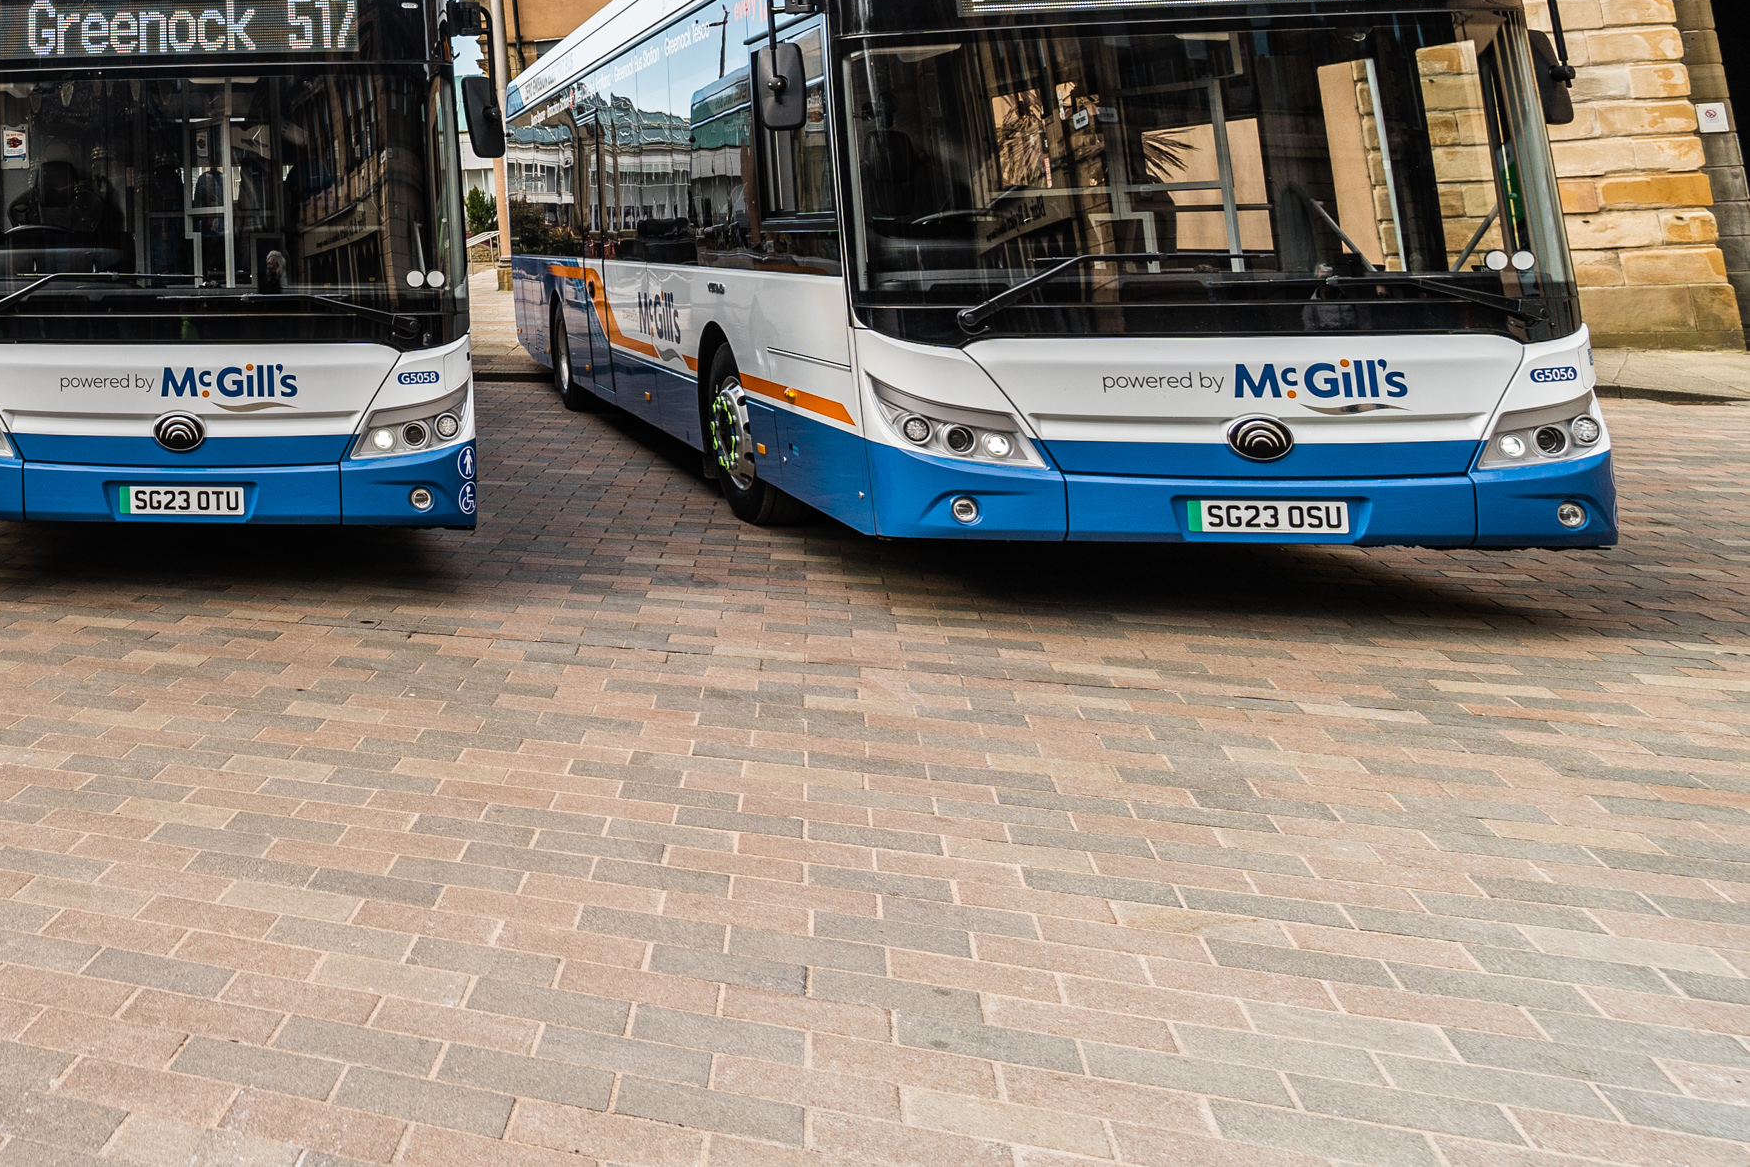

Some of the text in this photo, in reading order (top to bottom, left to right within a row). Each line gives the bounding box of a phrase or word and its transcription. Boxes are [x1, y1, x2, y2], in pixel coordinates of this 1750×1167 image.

[664, 28, 692, 57] Greenock
[691, 21, 709, 44] Tesco
[637, 290, 682, 345] McGill's
[59, 363, 298, 398] powered by McGill's
[400, 372, 437, 384] G5058
[1102, 358, 1408, 400] powered by McGill's
[1533, 367, 1575, 382] G5056
[134, 489, 239, 511] SG23 OTU
[1207, 504, 1343, 529] SG23 OSU
